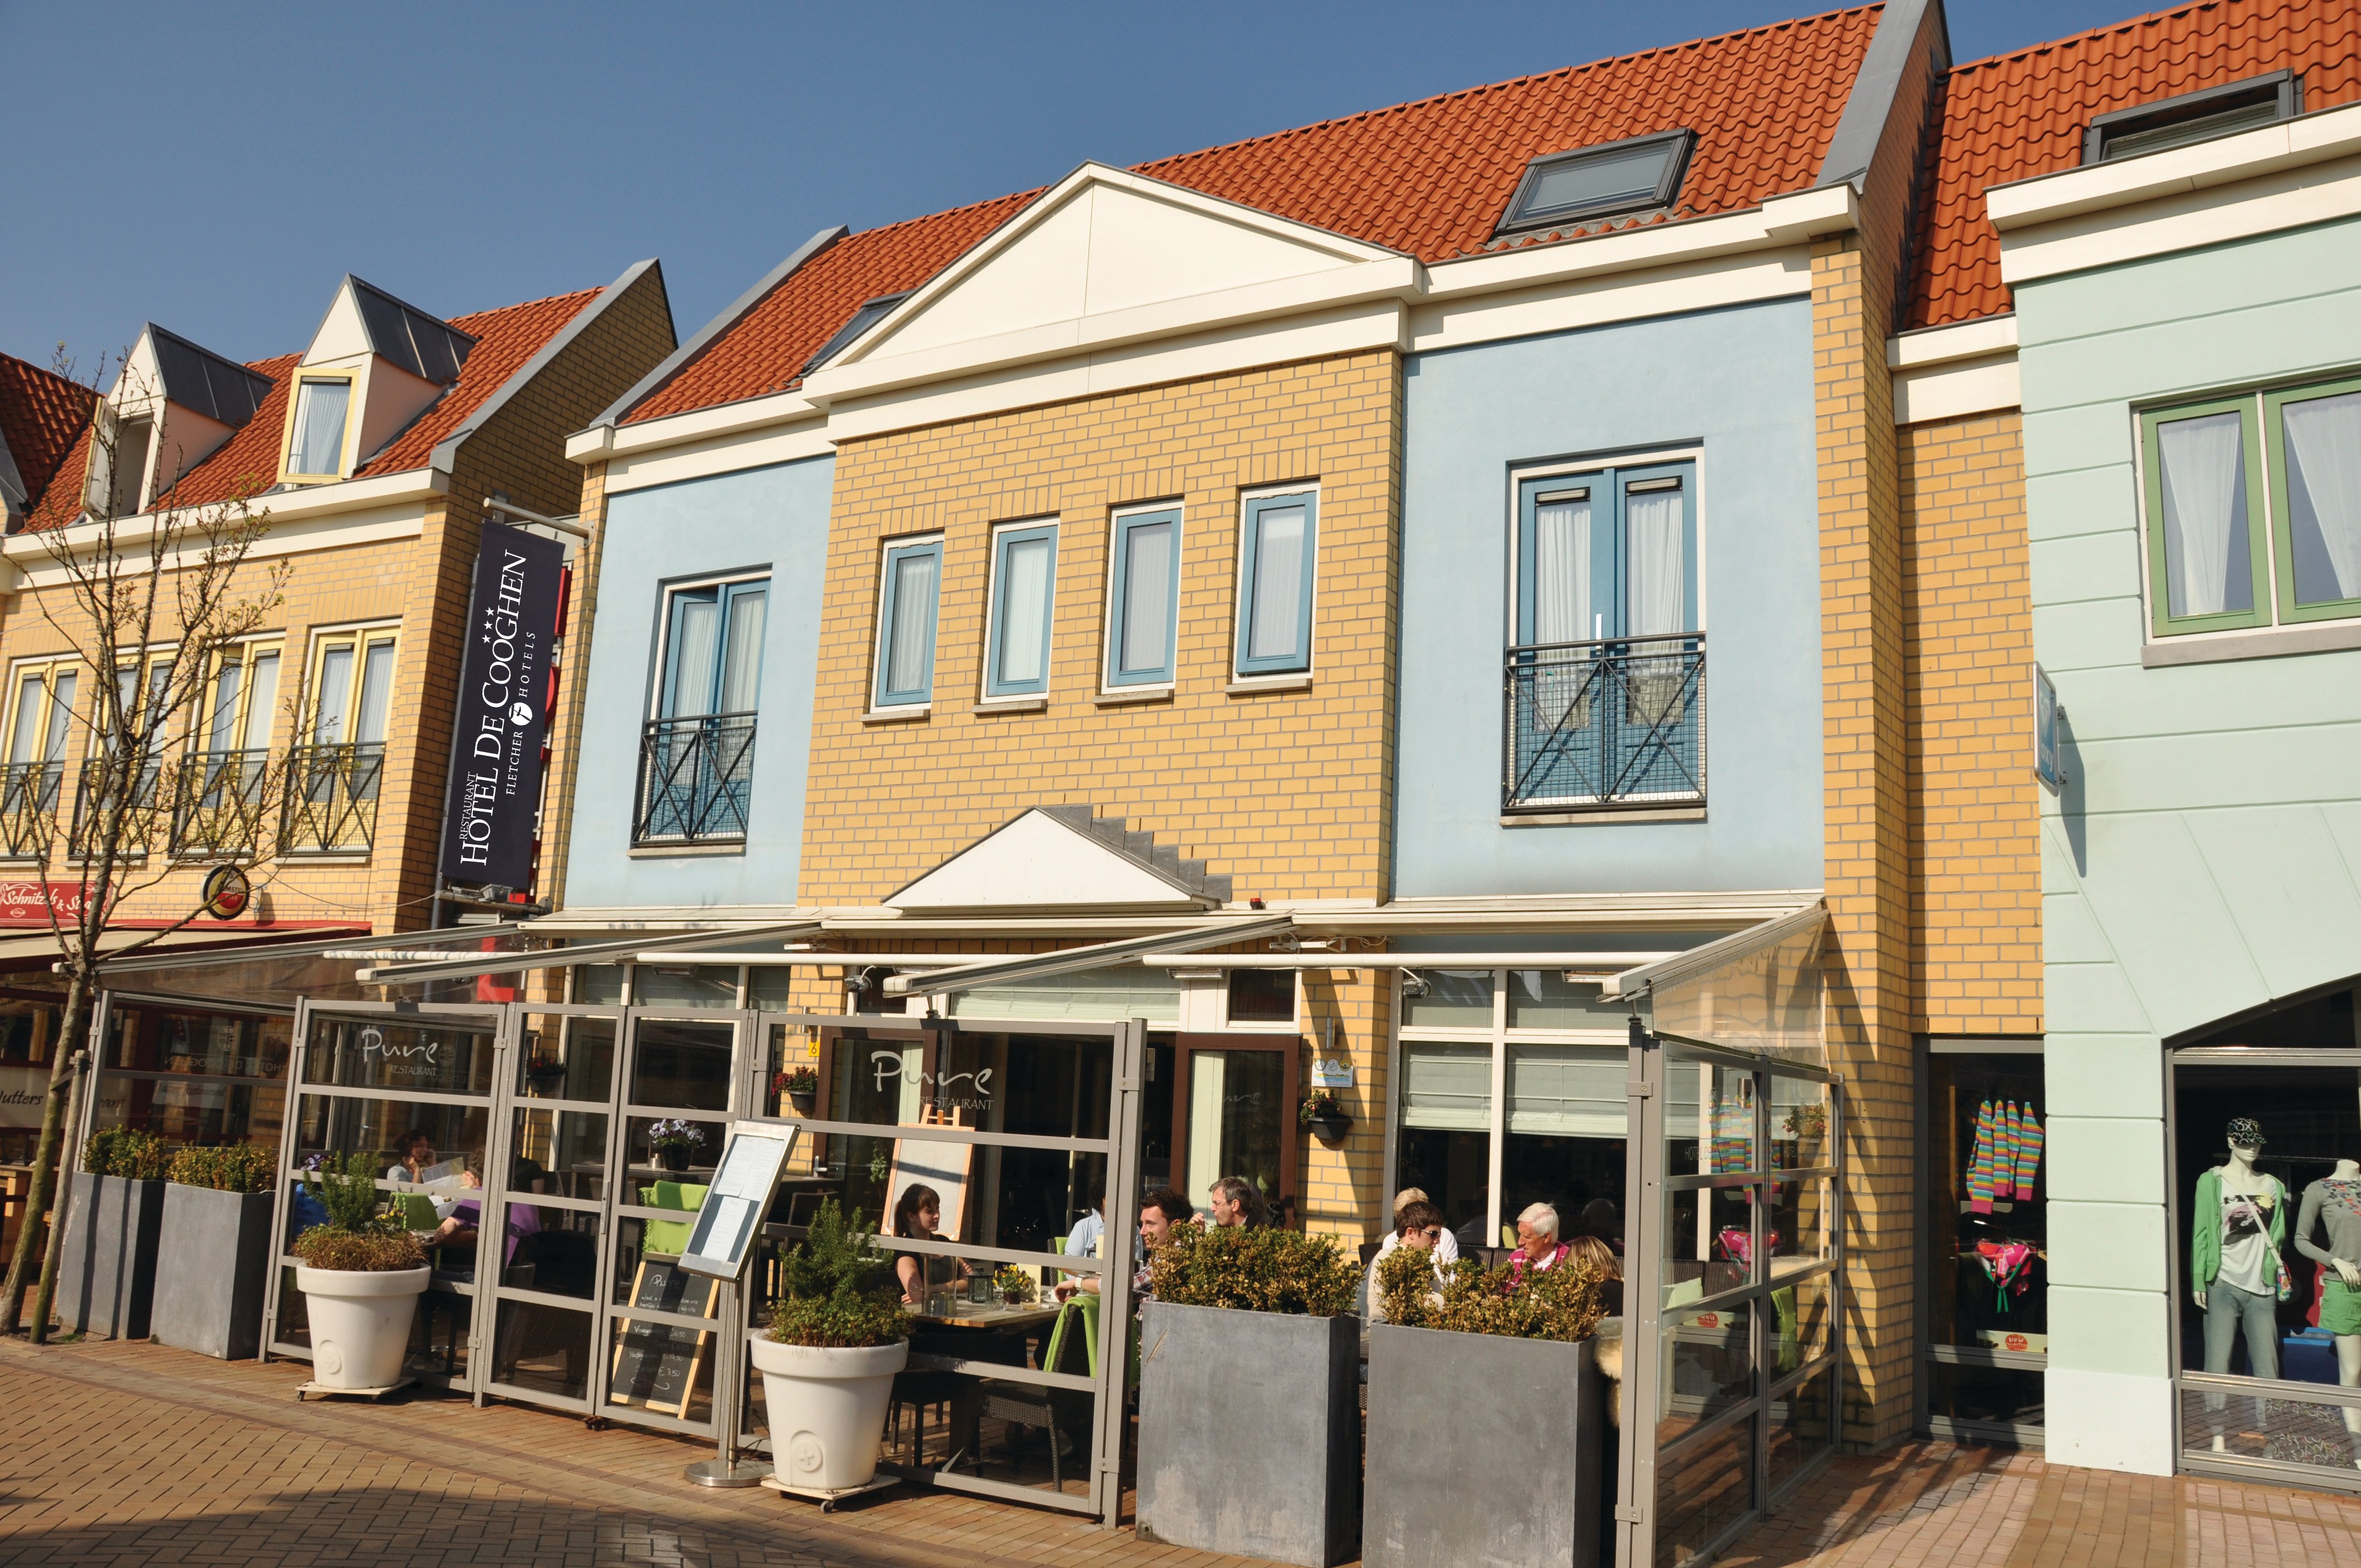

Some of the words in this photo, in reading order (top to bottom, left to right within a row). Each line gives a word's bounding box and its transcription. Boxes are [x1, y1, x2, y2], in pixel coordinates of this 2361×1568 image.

[482, 549, 526, 707] COOGHEN
[506, 731, 523, 796] FLETCHER
[519, 631, 535, 698] HOTELS
[474, 715, 505, 760] DE
[459, 771, 477, 841] RESTAURANT
[460, 767, 499, 866] HOTEL
[57, 899, 64, 912] &
[362, 1028, 438, 1064] Pure
[811, 1043, 817, 1054] 6
[390, 1065, 438, 1076] RESTAURANT
[871, 1050, 993, 1095] Pure
[920, 1096, 994, 1110] RESTAURANT
